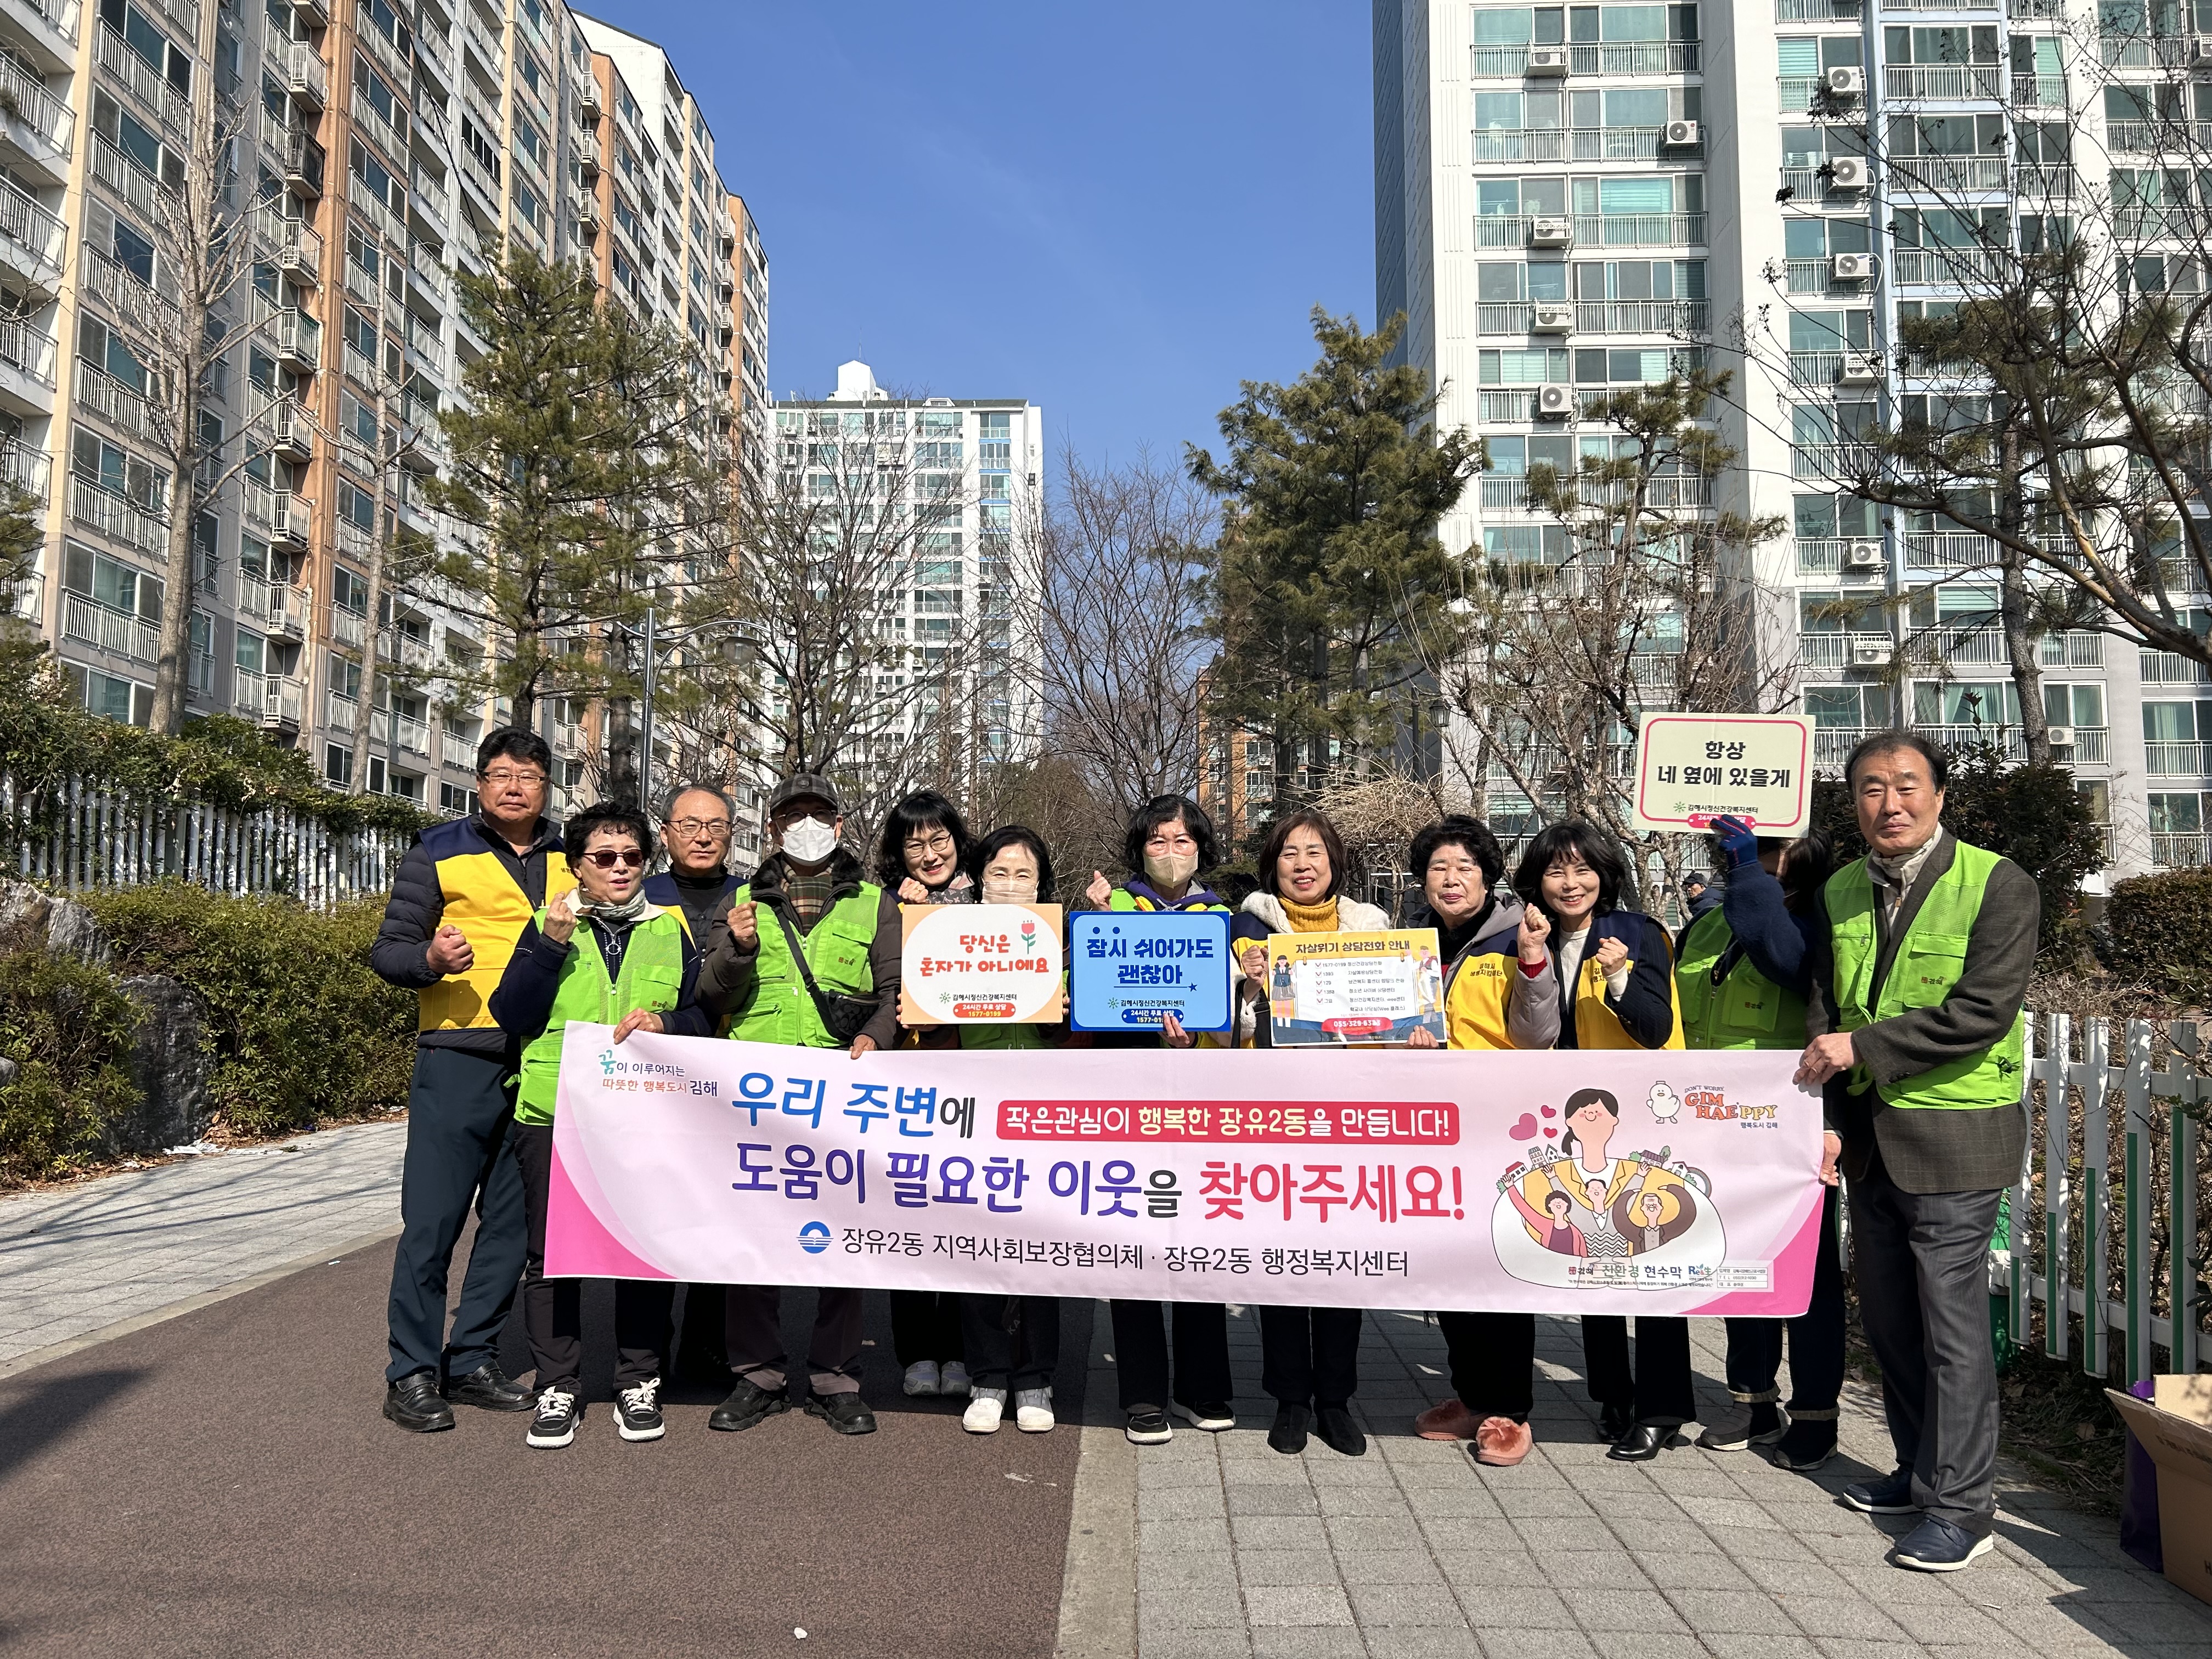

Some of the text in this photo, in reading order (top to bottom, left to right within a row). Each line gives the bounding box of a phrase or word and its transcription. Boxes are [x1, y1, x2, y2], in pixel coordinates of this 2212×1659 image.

[1705, 741, 1746, 760] 항상
[1657, 766, 1791, 788] 네 옆에 있을게
[960, 934, 1011, 953] 당신은
[1086, 939, 1214, 958] 잠시 쉬어가도
[1295, 940, 1410, 953] 자살위기 상담전화 안내
[920, 957, 1049, 977] 혼자가 아니에요
[1117, 964, 1182, 984] 괜찮아
[598, 1049, 685, 1077] 꿈이 이루어지는
[602, 1079, 718, 1097] 따뜻한 행복도시 김해
[732, 1073, 975, 1138] 우리 주변에
[1685, 1092, 1724, 1107] GIM
[1006, 1107, 1449, 1137] 작은관심이 행복한 장유2동을 만듭니다!
[732, 1143, 1464, 1223] 도움이 필요한 이웃을 찾아주세요!
[842, 1228, 924, 1256] 장유2동
[933, 1234, 1143, 1269] 지역사회보장협의체
[1164, 1246, 1252, 1272] 장유2동
[1261, 1248, 1408, 1277] 행정복지센터
[1644, 1266, 1682, 1279] 현수막
